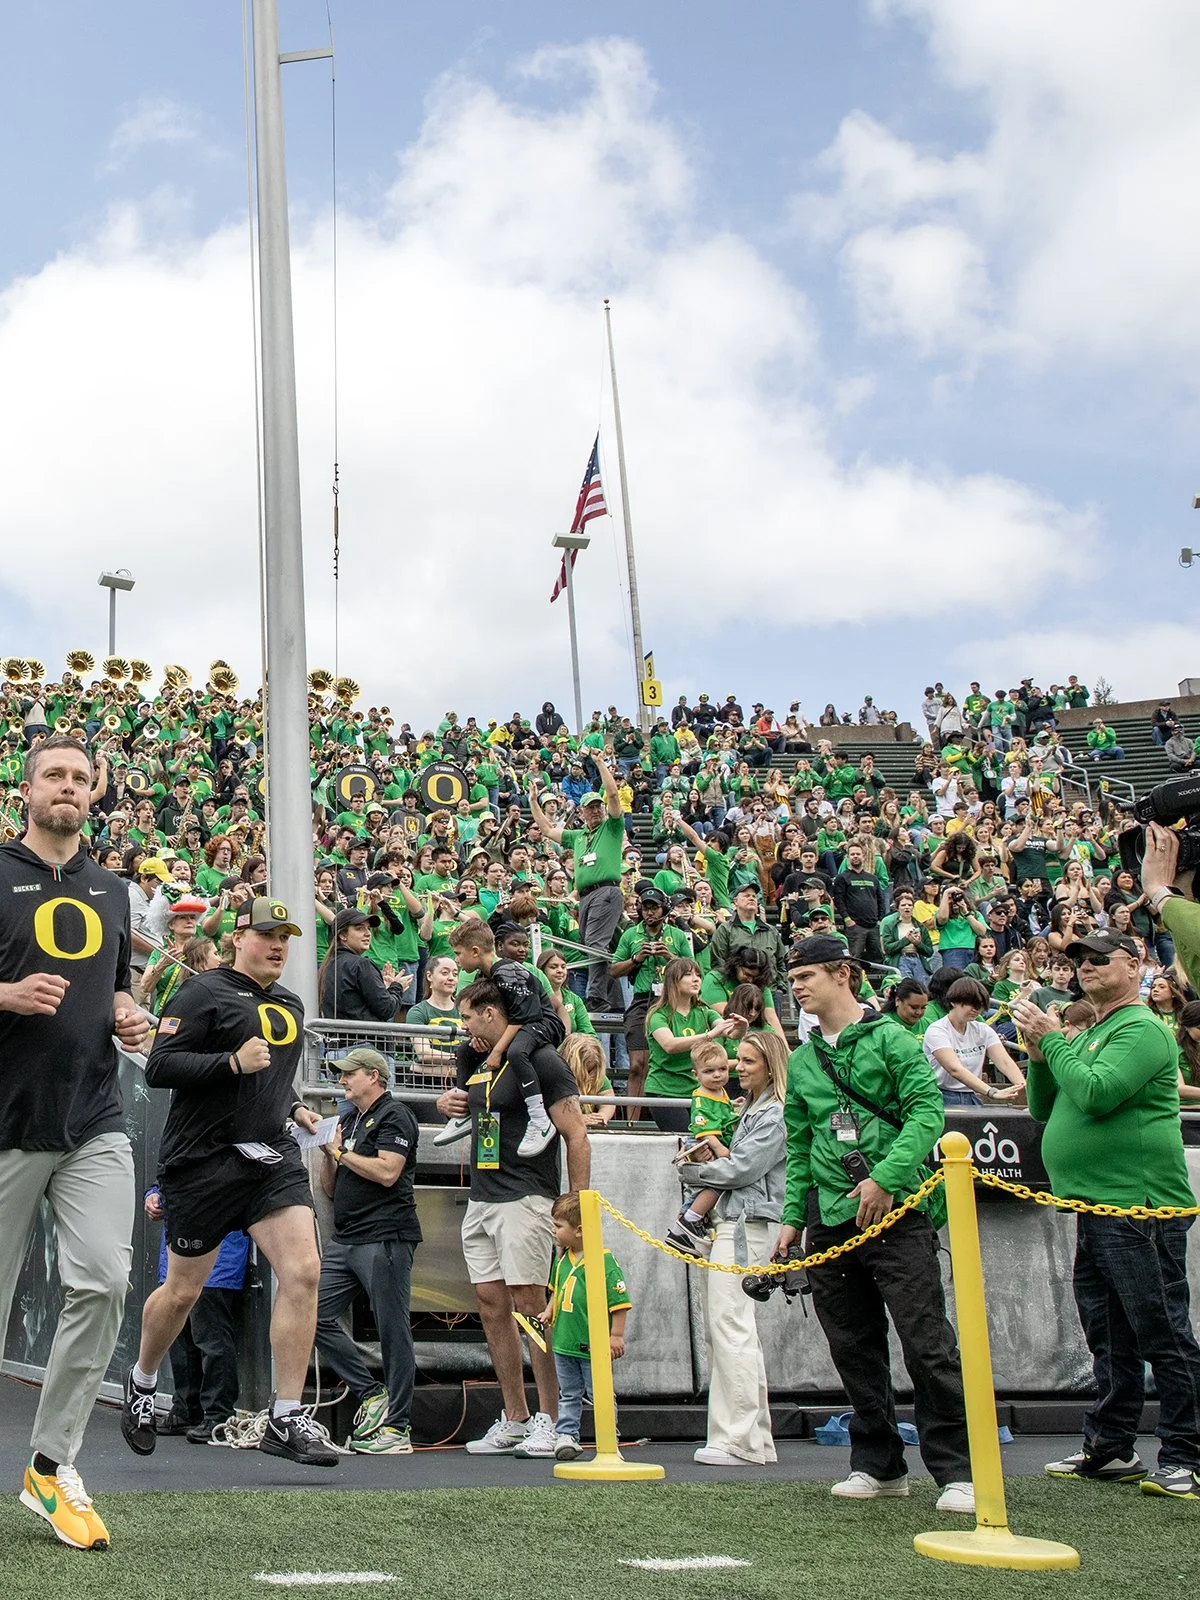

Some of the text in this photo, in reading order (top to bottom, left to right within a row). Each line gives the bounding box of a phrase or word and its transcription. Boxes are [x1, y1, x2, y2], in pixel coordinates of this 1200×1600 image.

[649, 685, 657, 699] 3
[341, 773, 376, 803] O
[427, 773, 463, 805] O
[273, 906, 287, 919] O
[34, 896, 103, 960] O
[258, 1003, 298, 1045] O
[981, 1167, 1022, 1178] HEALTH
